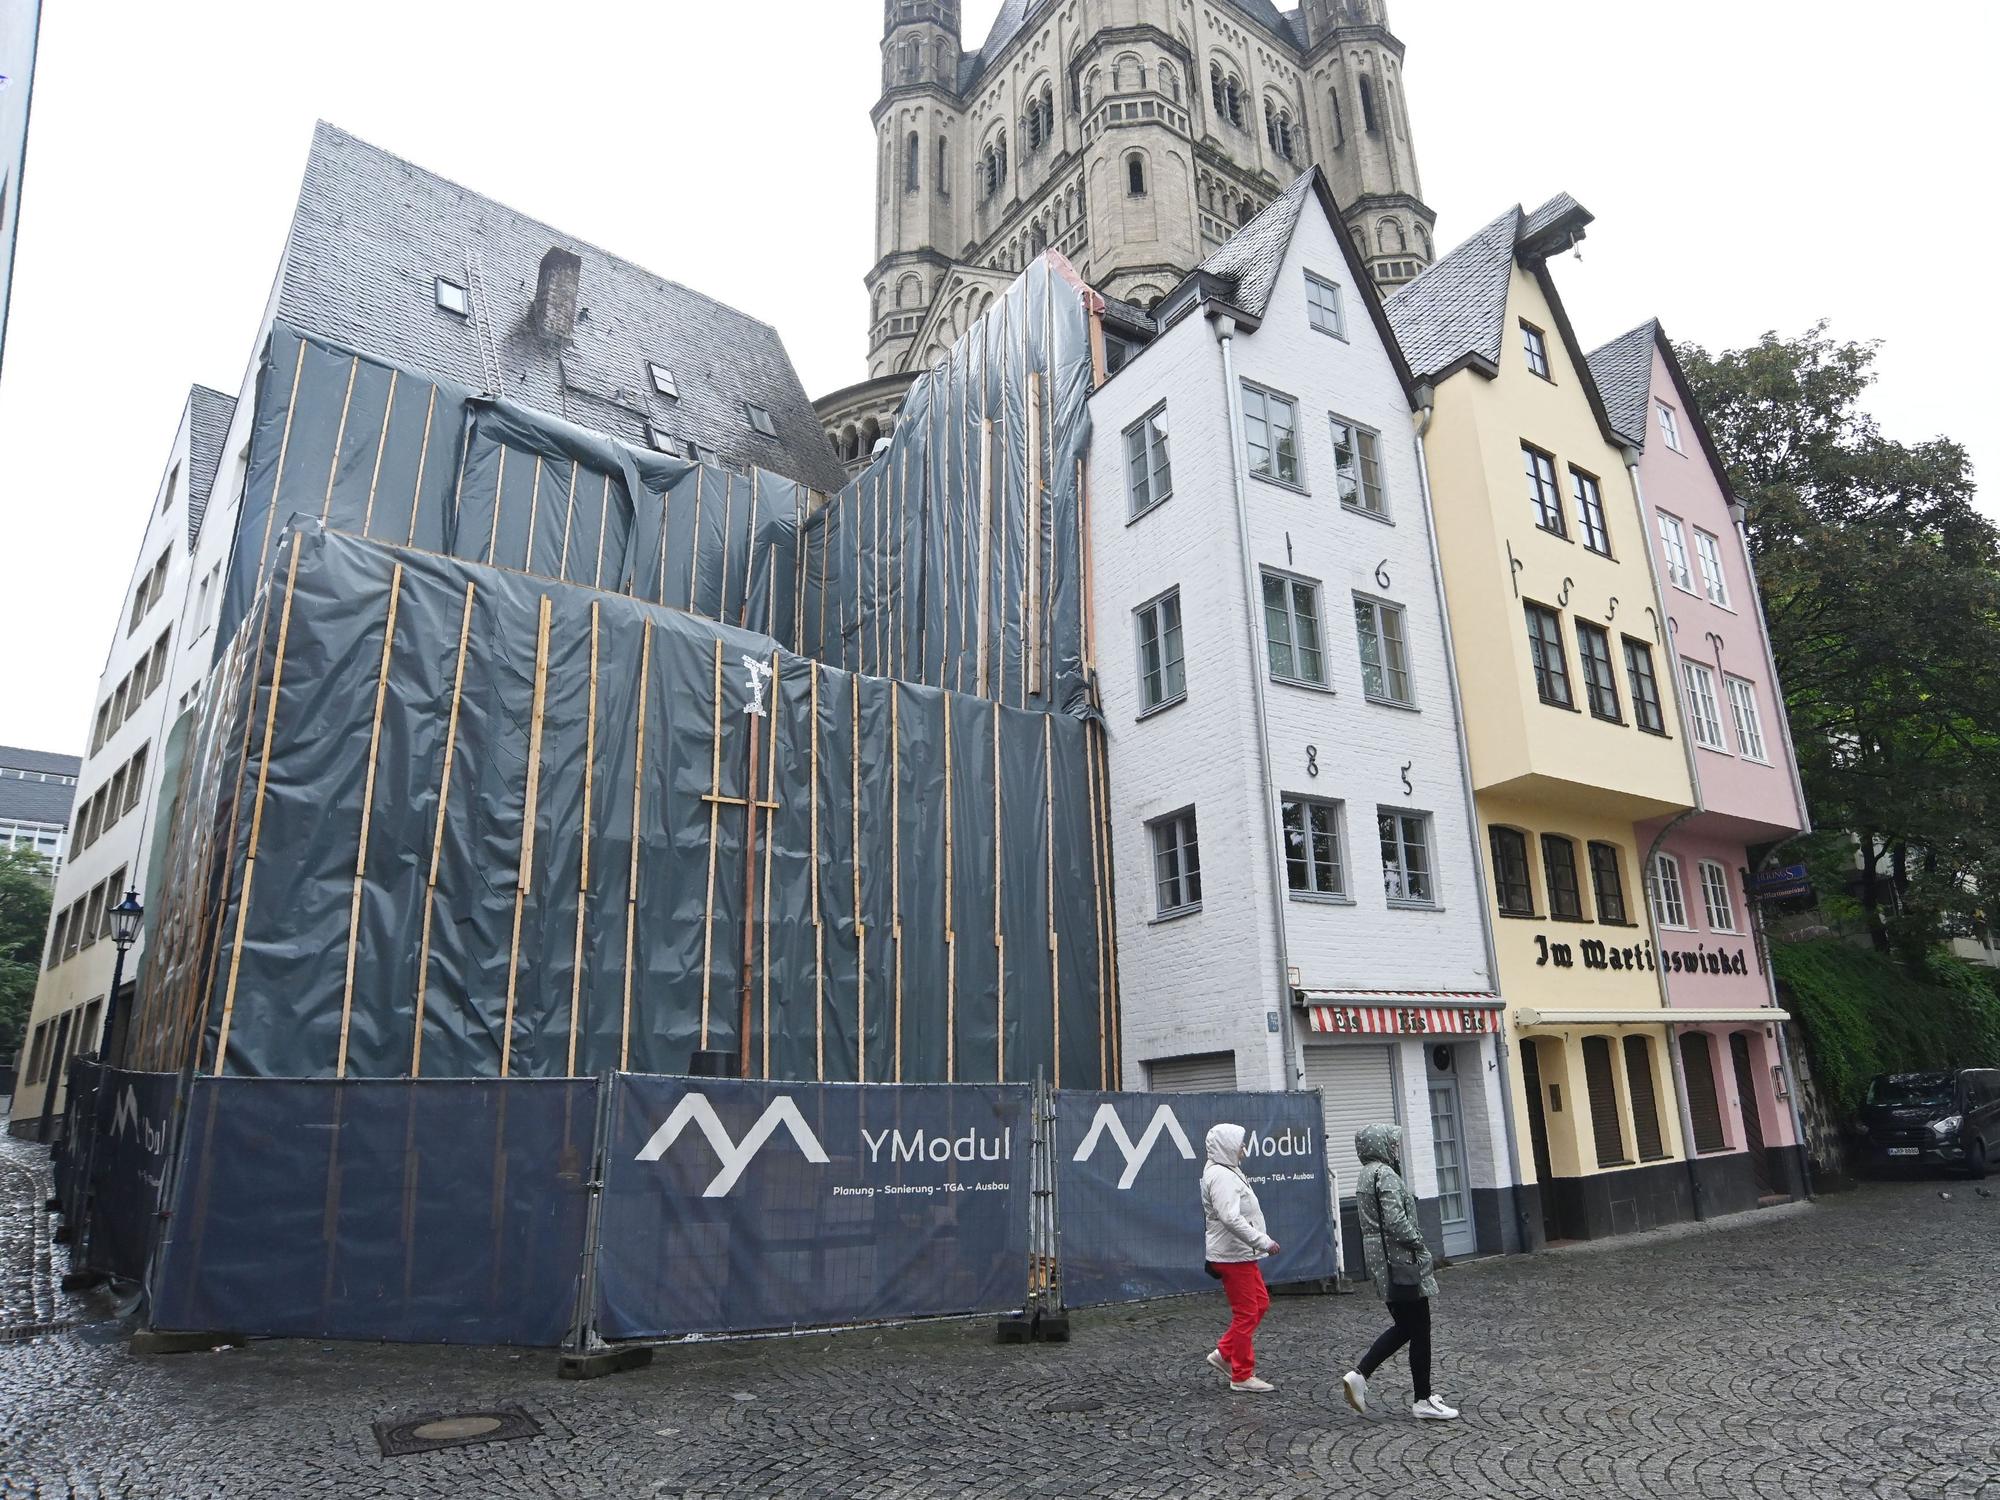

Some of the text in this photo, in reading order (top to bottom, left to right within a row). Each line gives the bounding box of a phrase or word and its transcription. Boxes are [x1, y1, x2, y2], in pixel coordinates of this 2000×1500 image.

[1534, 934, 1574, 968] Im
[1334, 1009, 1486, 1032] Eis Eis Eis
[861, 1126, 1010, 1163] YModul
[1272, 1173, 1286, 1182] TGA
[1293, 1171, 1315, 1180] Ausbau
[833, 1186, 875, 1198] Planung
[884, 1184, 934, 1196] Sanierung
[943, 1183, 965, 1192] TGA
[975, 1181, 1010, 1192] Ausbau
